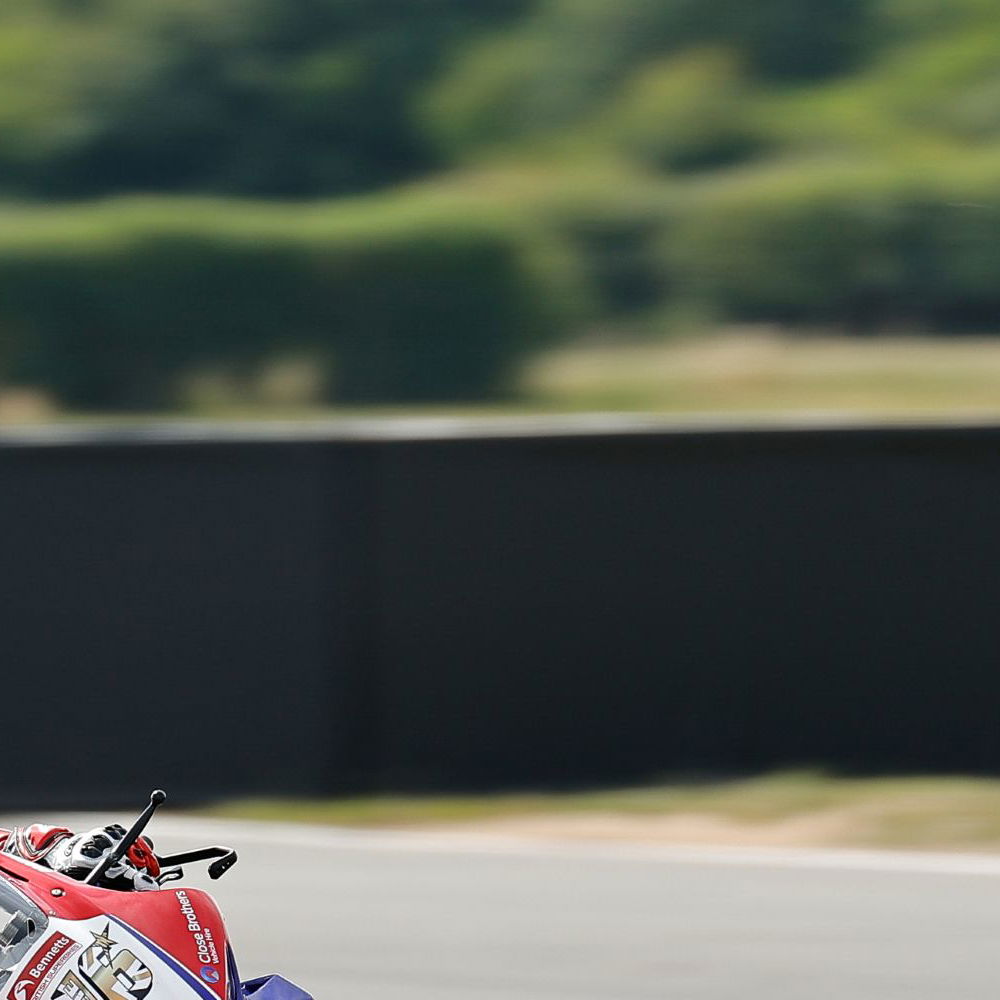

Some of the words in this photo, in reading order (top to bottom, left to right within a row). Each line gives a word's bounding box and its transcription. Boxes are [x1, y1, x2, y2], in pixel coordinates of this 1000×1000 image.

[175, 890, 201, 932] Brothers
[29, 936, 70, 979] Bennetts
[194, 932, 211, 964] Close
